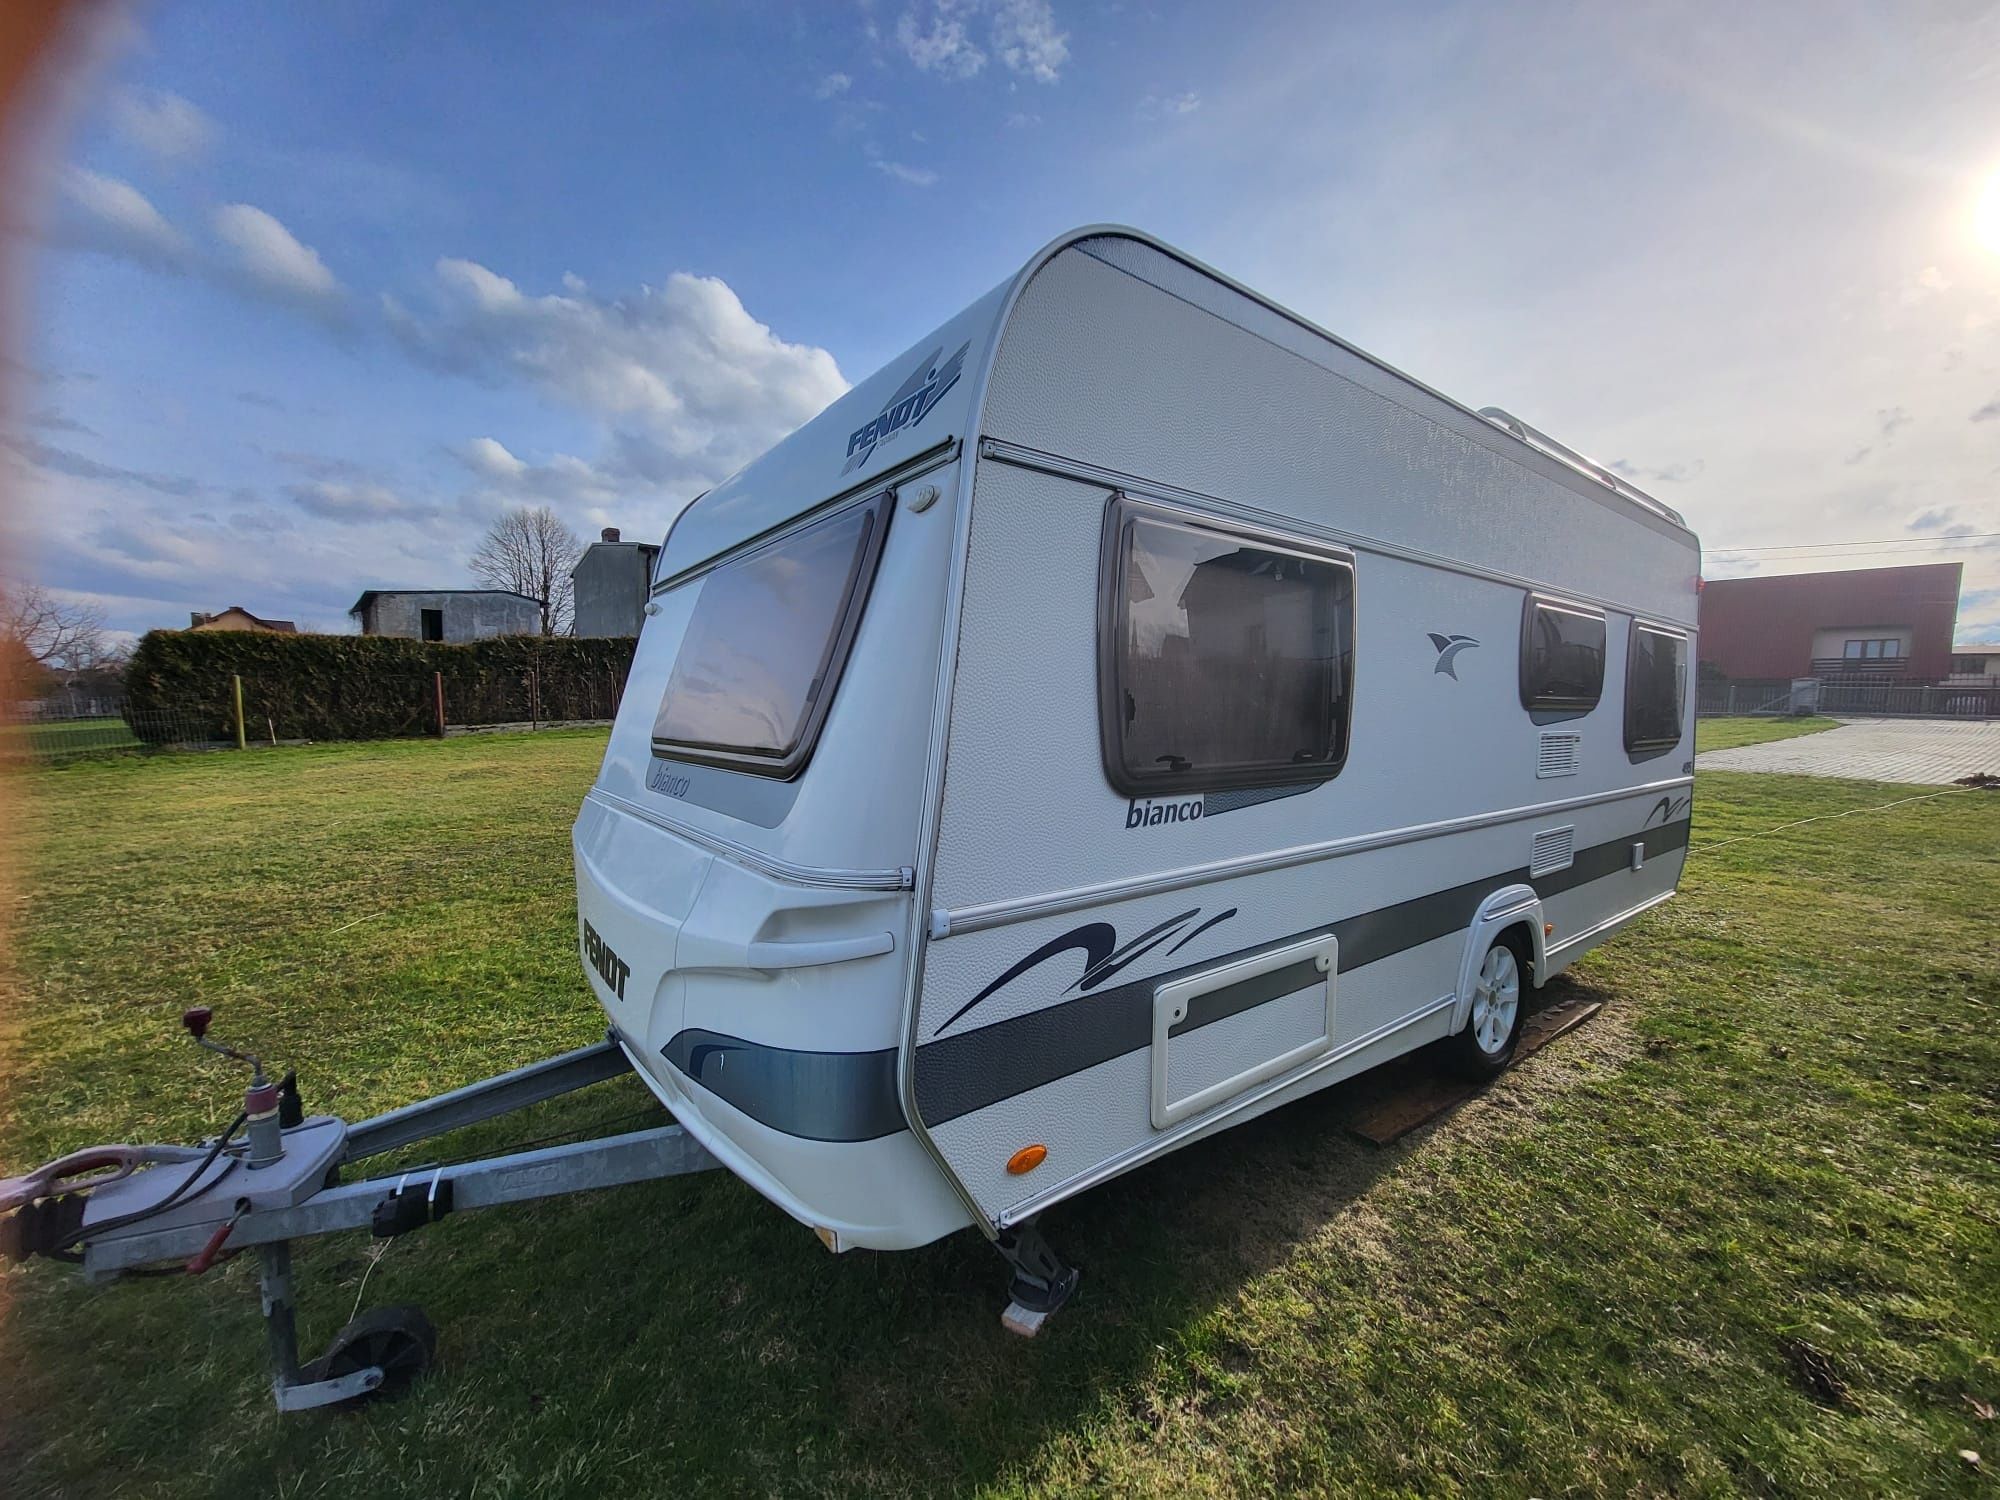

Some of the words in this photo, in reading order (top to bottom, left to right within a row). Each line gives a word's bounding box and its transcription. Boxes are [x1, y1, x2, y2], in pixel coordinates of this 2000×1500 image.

[847, 380, 937, 457] FENDT
[652, 762, 690, 797] bianco
[1126, 798, 1202, 828] bianco
[584, 918, 630, 1002] FENDT
